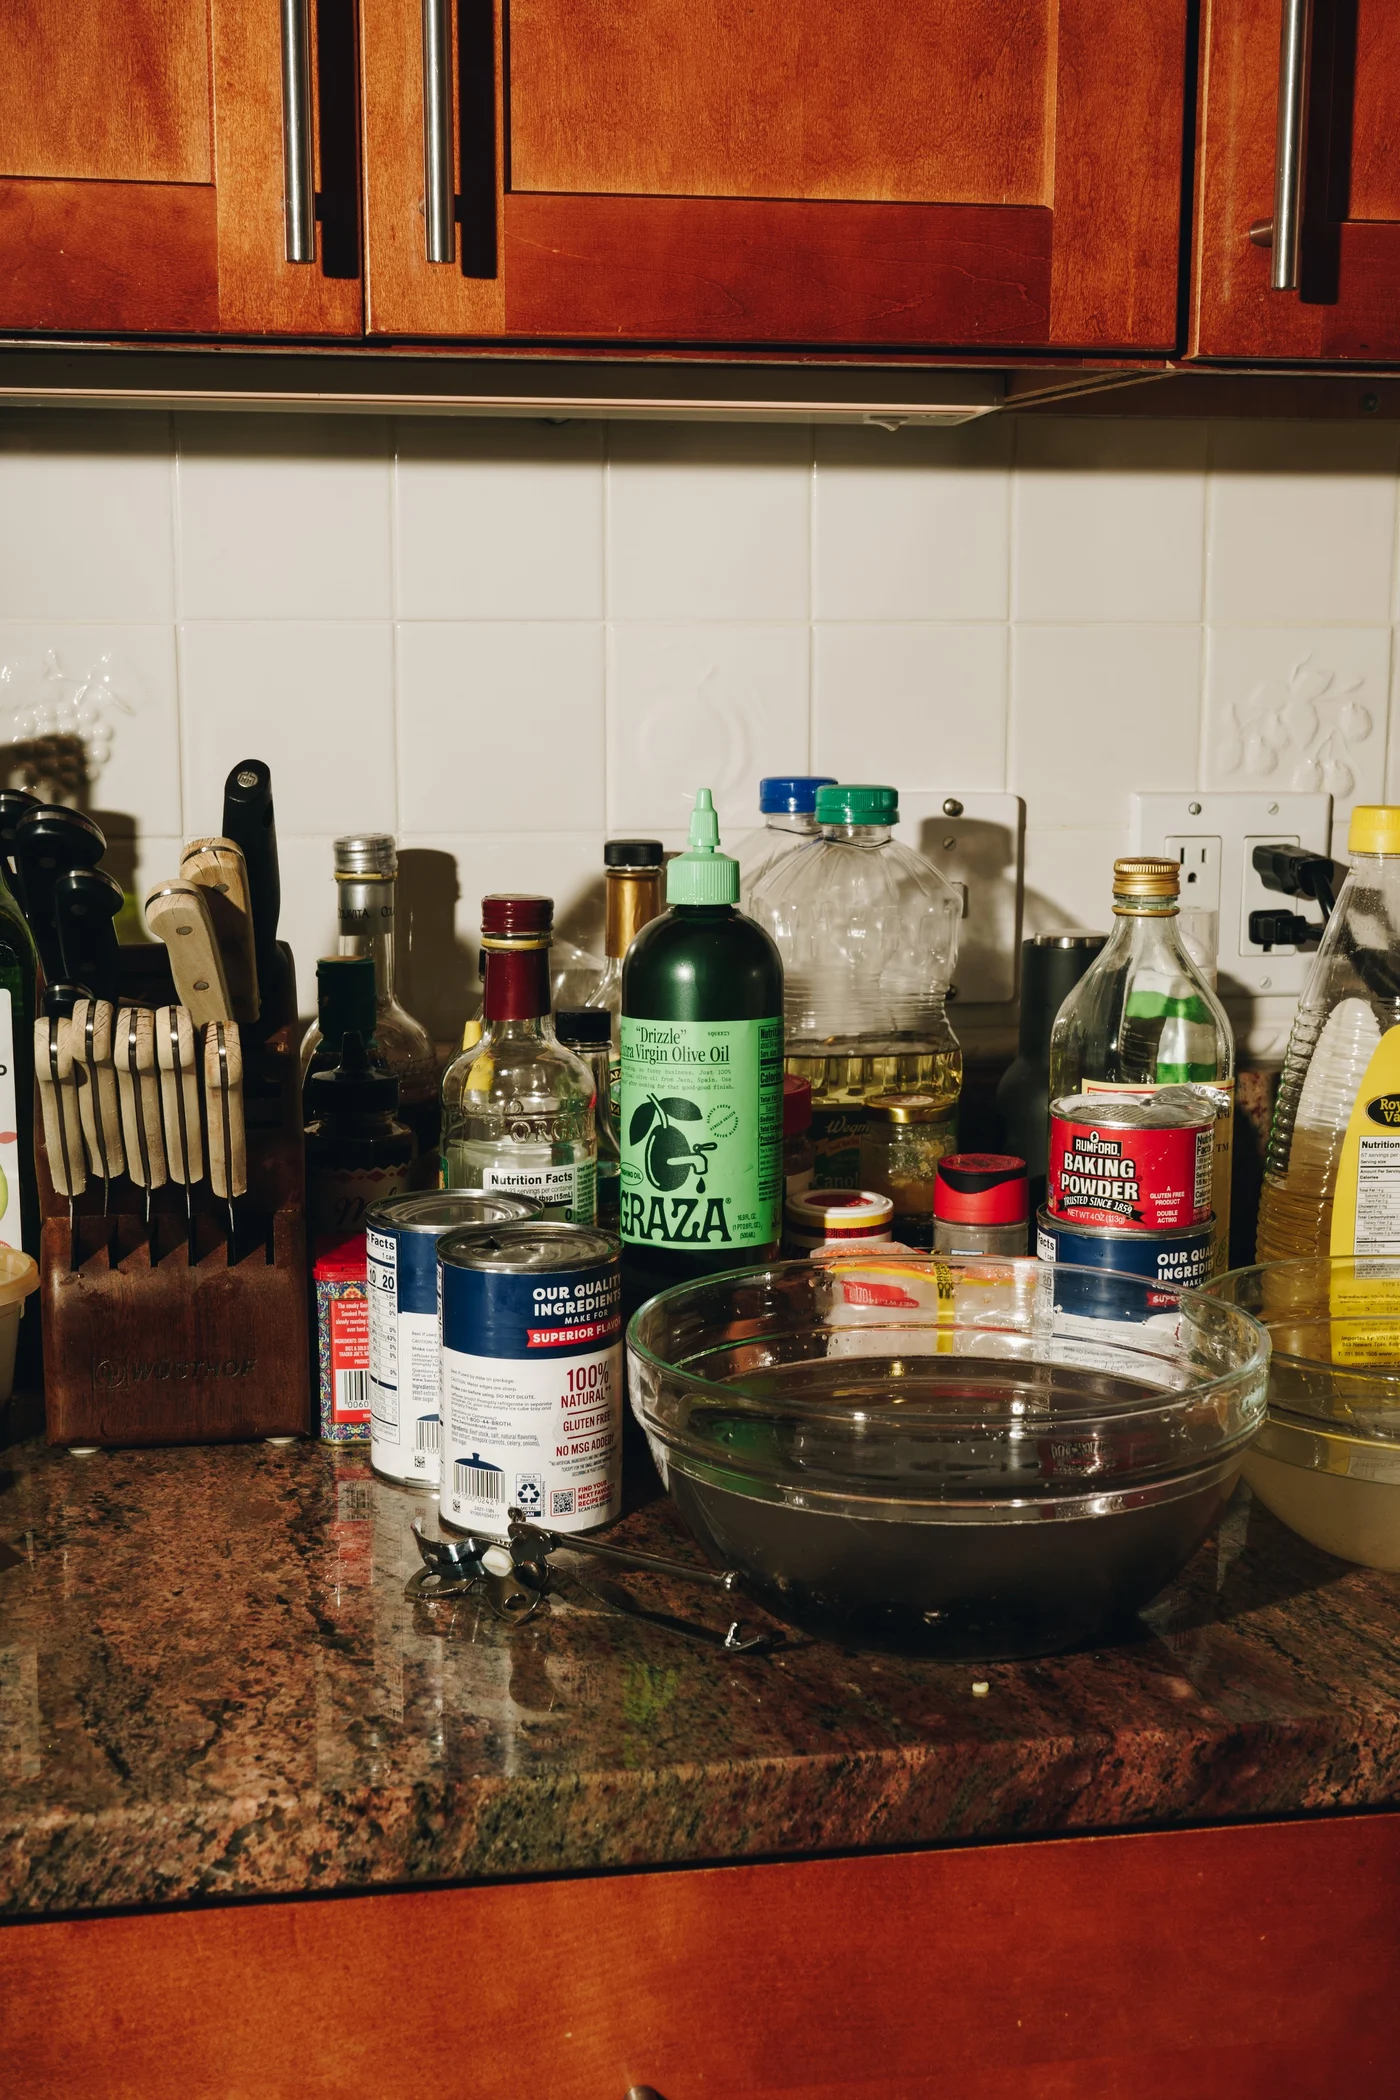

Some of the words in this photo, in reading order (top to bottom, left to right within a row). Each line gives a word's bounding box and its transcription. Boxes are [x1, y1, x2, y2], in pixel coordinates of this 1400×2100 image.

[636, 1044, 668, 1065] Virgin
[672, 1046, 706, 1062] Olive
[710, 1045, 730, 1062] Oil
[1380, 1099, 1400, 1113] Roy
[1075, 1138, 1118, 1155] RUMFORD
[1361, 1141, 1400, 1149] Nutrition
[1064, 1152, 1135, 1178] BAKING
[491, 1175, 542, 1186] Nutrition
[546, 1172, 573, 1184] Facts
[815, 1172, 860, 1189] Canol
[1061, 1173, 1139, 1200] POWDER
[541, 1187, 550, 1196] per
[551, 1184, 573, 1193] container
[554, 1191, 573, 1200] (15mL)
[1064, 1195, 1088, 1206] TRUSTED
[1088, 1196, 1112, 1209] SINCE
[1113, 1202, 1133, 1215] 1859
[1155, 1198, 1180, 1206] PRODUCT
[565, 1208, 572, 1221] 0
[1067, 1208, 1079, 1217] NET
[1079, 1210, 1090, 1219] WT
[1105, 1216, 1126, 1225] (113g)
[371, 1233, 395, 1250] Facts
[1157, 1251, 1188, 1266] OUR
[382, 1275, 395, 1290] 20
[1183, 1278, 1201, 1287] MAKE
[533, 1286, 570, 1301] OUR
[564, 1313, 591, 1325] MAKE
[594, 1308, 608, 1320] FOR
[533, 1327, 594, 1343] SUPERIOR
[567, 1361, 609, 1392] 100%
[563, 1415, 595, 1432] GLUTEN
[596, 1410, 611, 1426] FREE
[489, 1437, 506, 1446] (carrots,
[517, 1433, 538, 1441] flavoring,
[556, 1445, 569, 1457] NO
[571, 1442, 590, 1455] MSG
[578, 1485, 593, 1493] FIND
[593, 1480, 608, 1489] YOUR
[477, 1497, 500, 1506] 02421
[578, 1492, 594, 1500] NEXT
[578, 1498, 599, 1507] RECIPE
